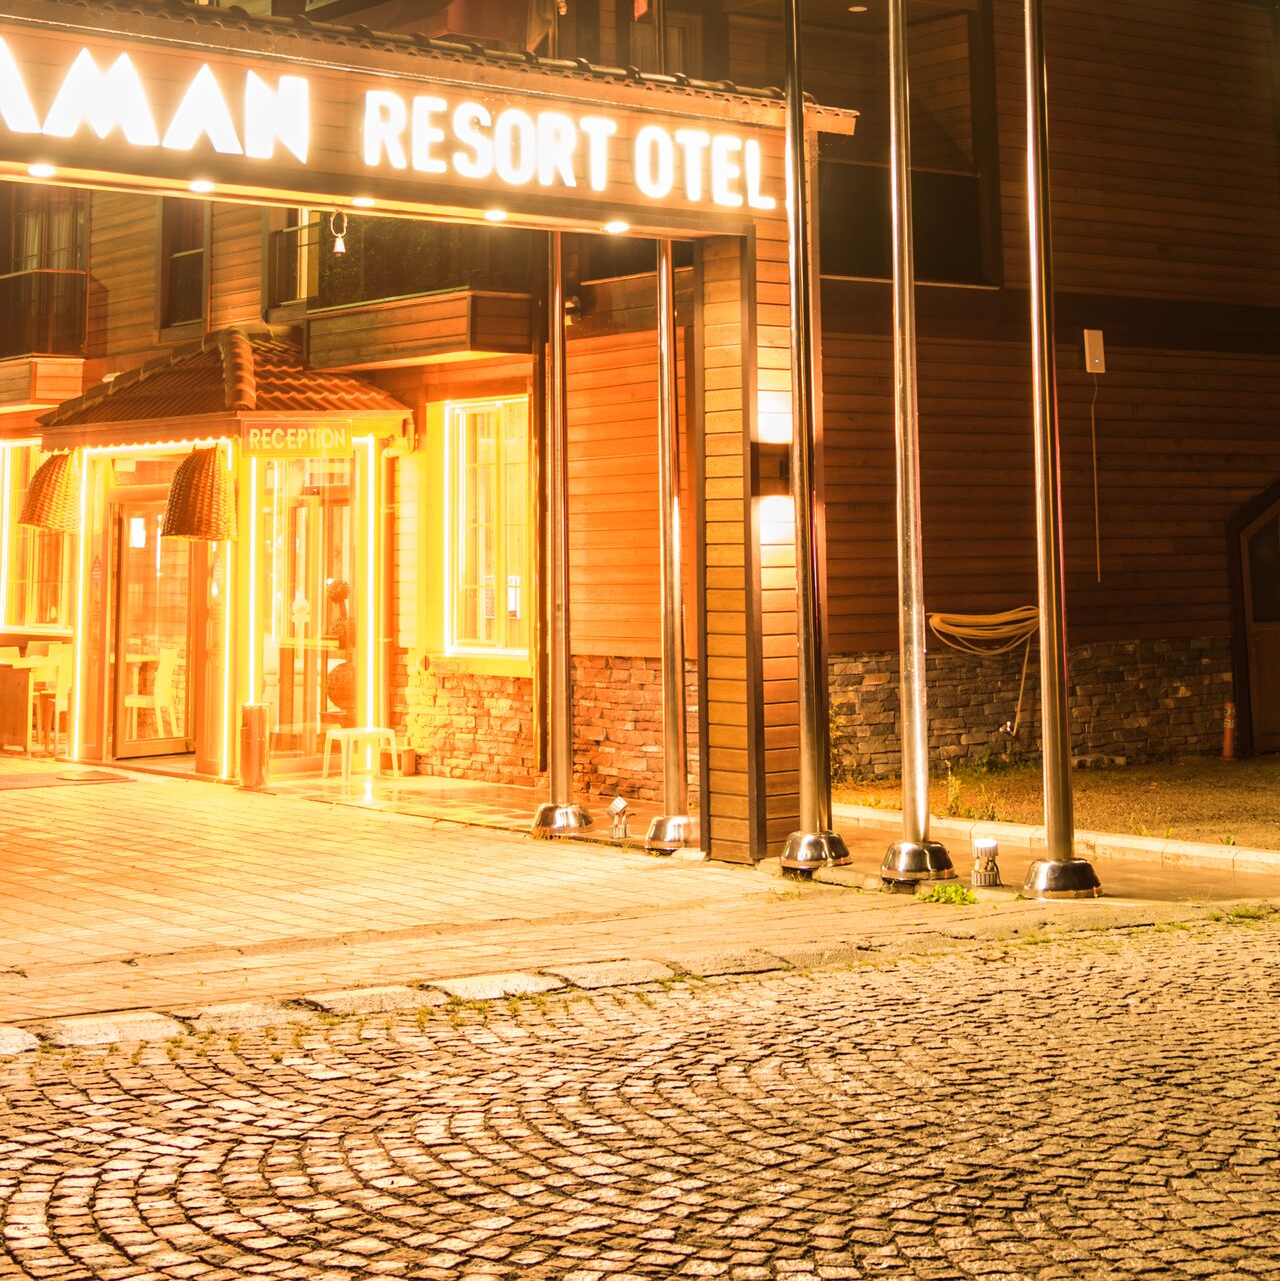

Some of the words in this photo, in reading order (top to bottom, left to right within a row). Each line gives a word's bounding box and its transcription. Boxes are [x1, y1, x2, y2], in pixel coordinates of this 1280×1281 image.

[362, 88, 619, 193] RESORT
[634, 125, 776, 210] OTEL
[249, 428, 346, 450] RECEPTION
